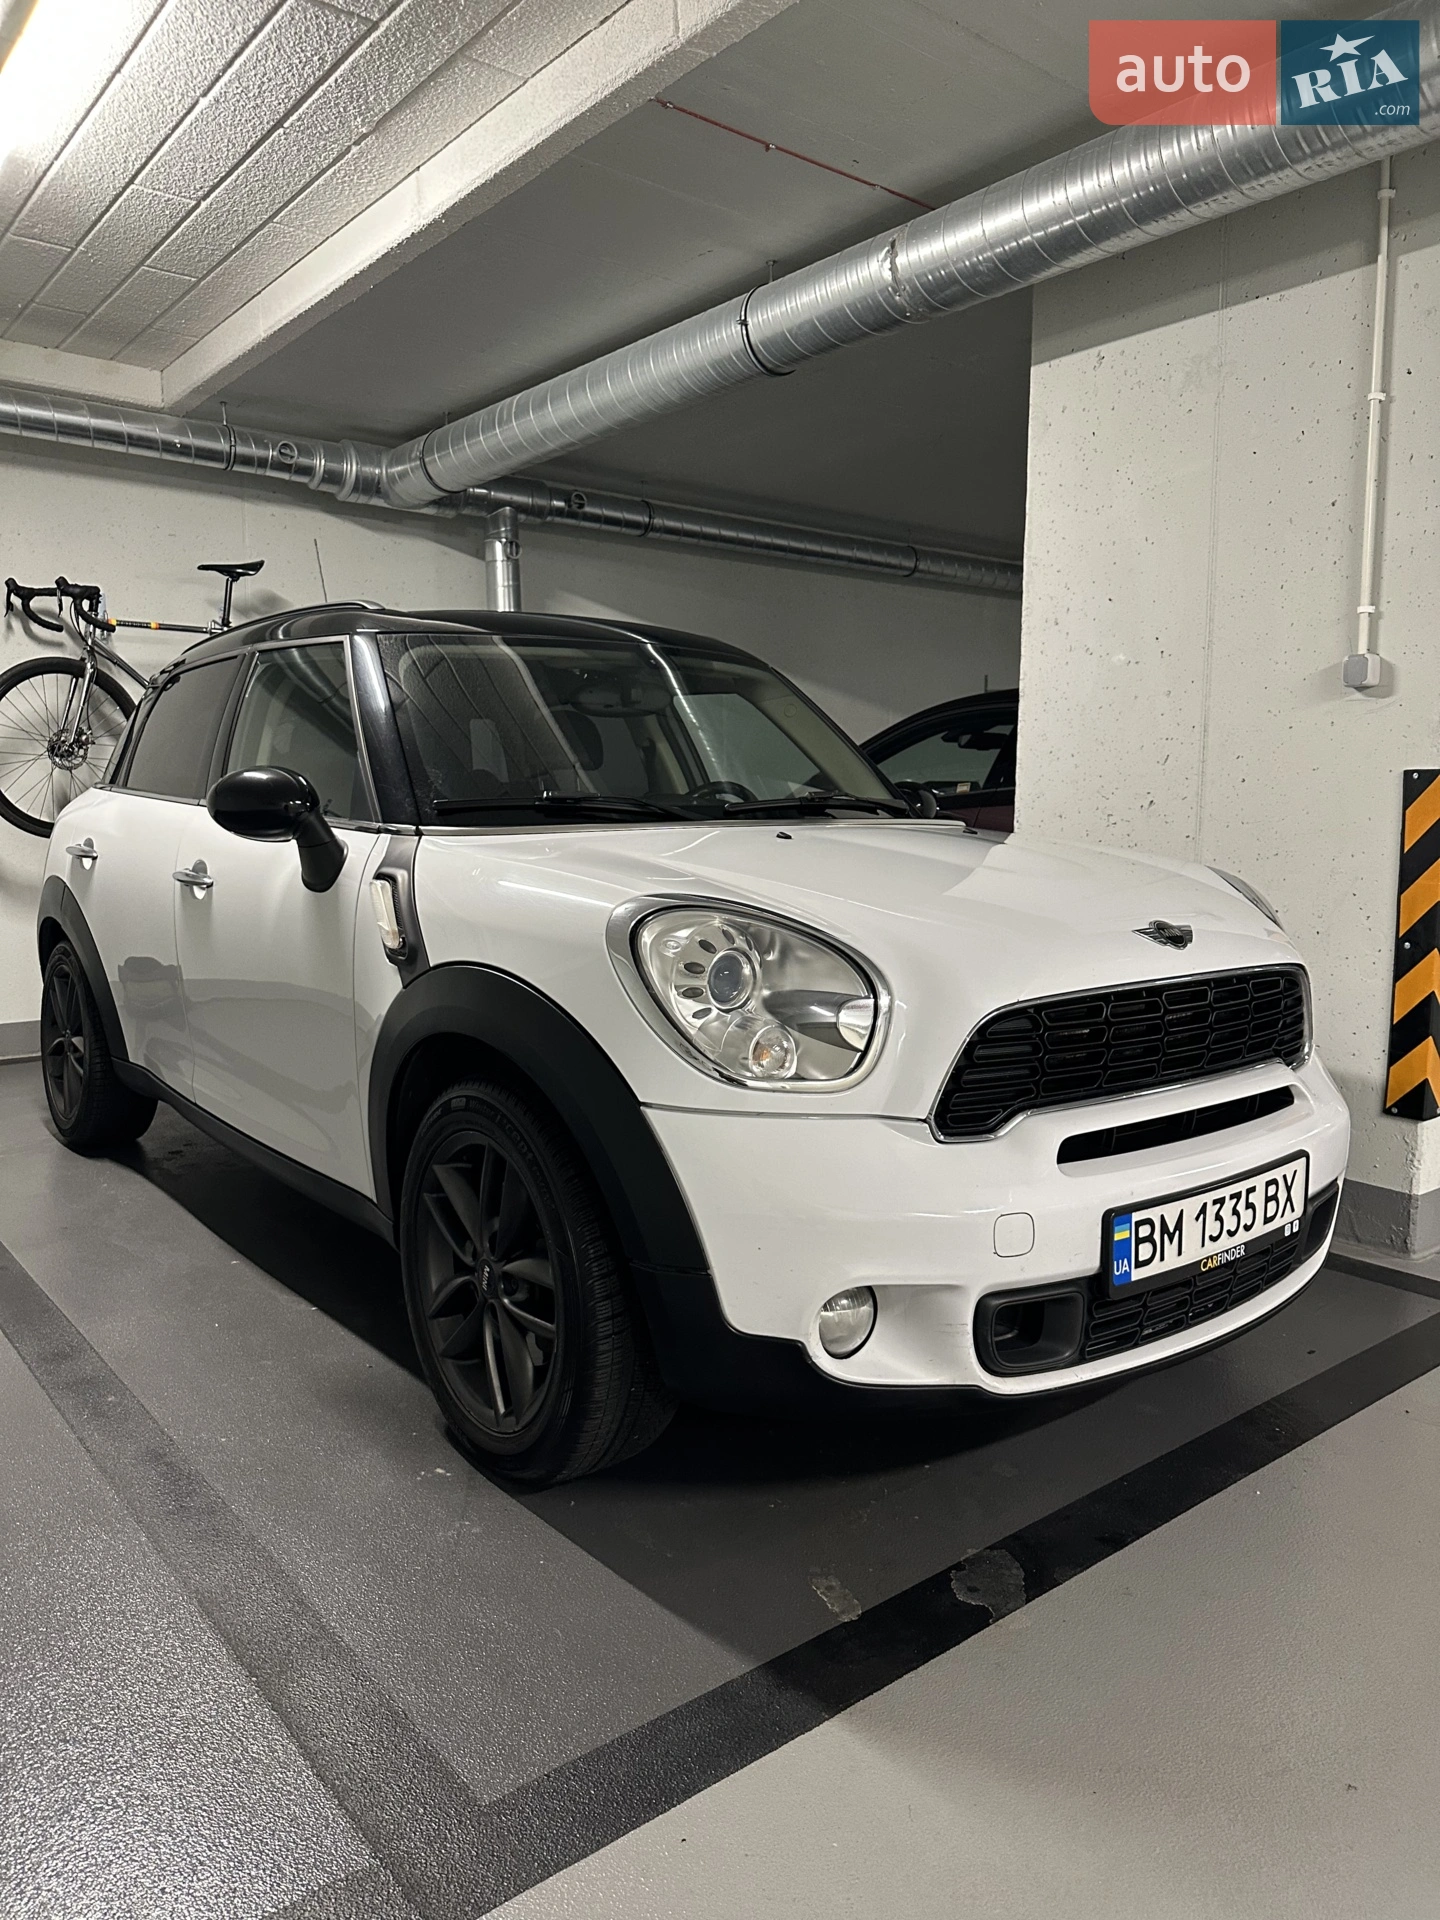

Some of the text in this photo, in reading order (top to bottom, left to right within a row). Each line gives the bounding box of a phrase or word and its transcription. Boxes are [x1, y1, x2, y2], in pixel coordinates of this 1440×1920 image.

[1134, 1169, 1298, 1270] BM 1335 BX
[1113, 1257, 1130, 1276] UA
[1200, 1244, 1245, 1271] CARFINDER
[482, 1264, 490, 1291] MINI
